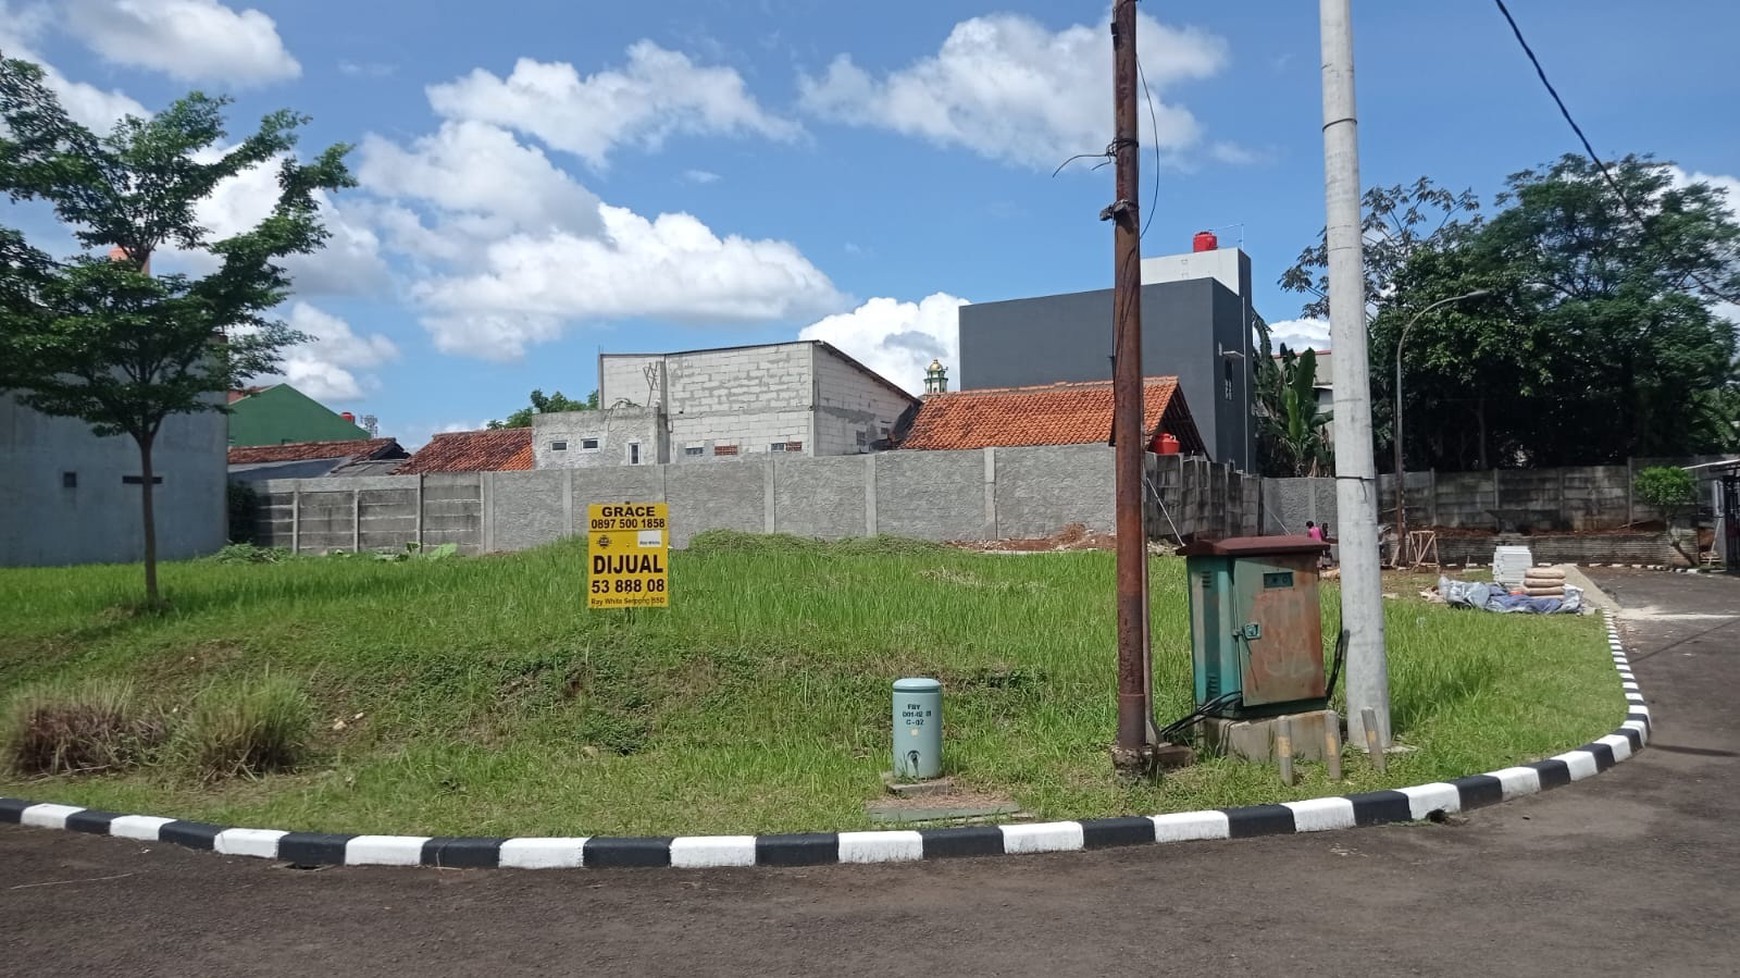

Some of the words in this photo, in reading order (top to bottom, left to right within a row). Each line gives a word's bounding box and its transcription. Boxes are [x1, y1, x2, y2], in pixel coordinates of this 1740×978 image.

[602, 506, 655, 517] GRACE
[591, 519, 616, 529] 0897
[619, 518, 638, 529] 500
[641, 518, 665, 529] 1858
[593, 555, 664, 574] DIJUAL
[592, 579, 610, 594] 53
[615, 579, 642, 593] 888
[647, 578, 664, 593] 08
[591, 598, 603, 606] Ray
